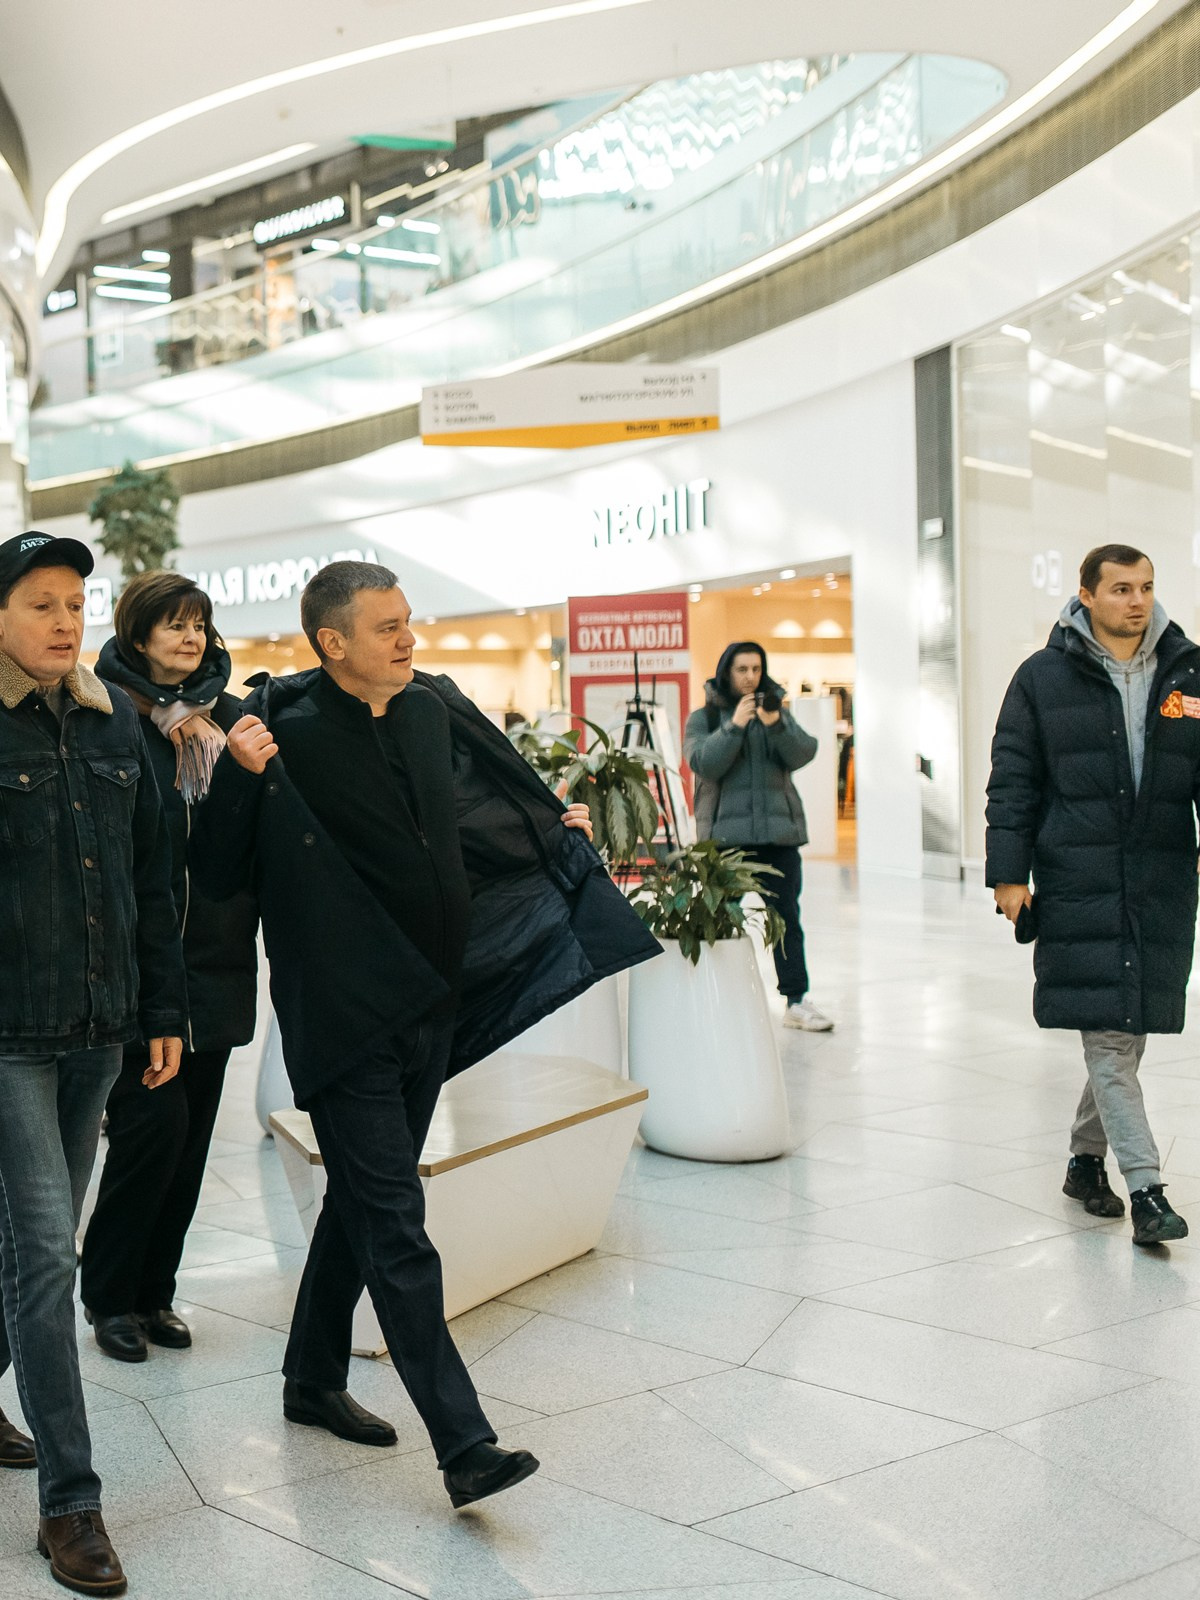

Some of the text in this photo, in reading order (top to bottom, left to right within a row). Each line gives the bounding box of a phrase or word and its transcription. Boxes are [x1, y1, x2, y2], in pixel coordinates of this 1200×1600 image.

[588, 478, 712, 552] NEOHIT
[578, 622, 683, 651] ОХТА МОЛЛ
